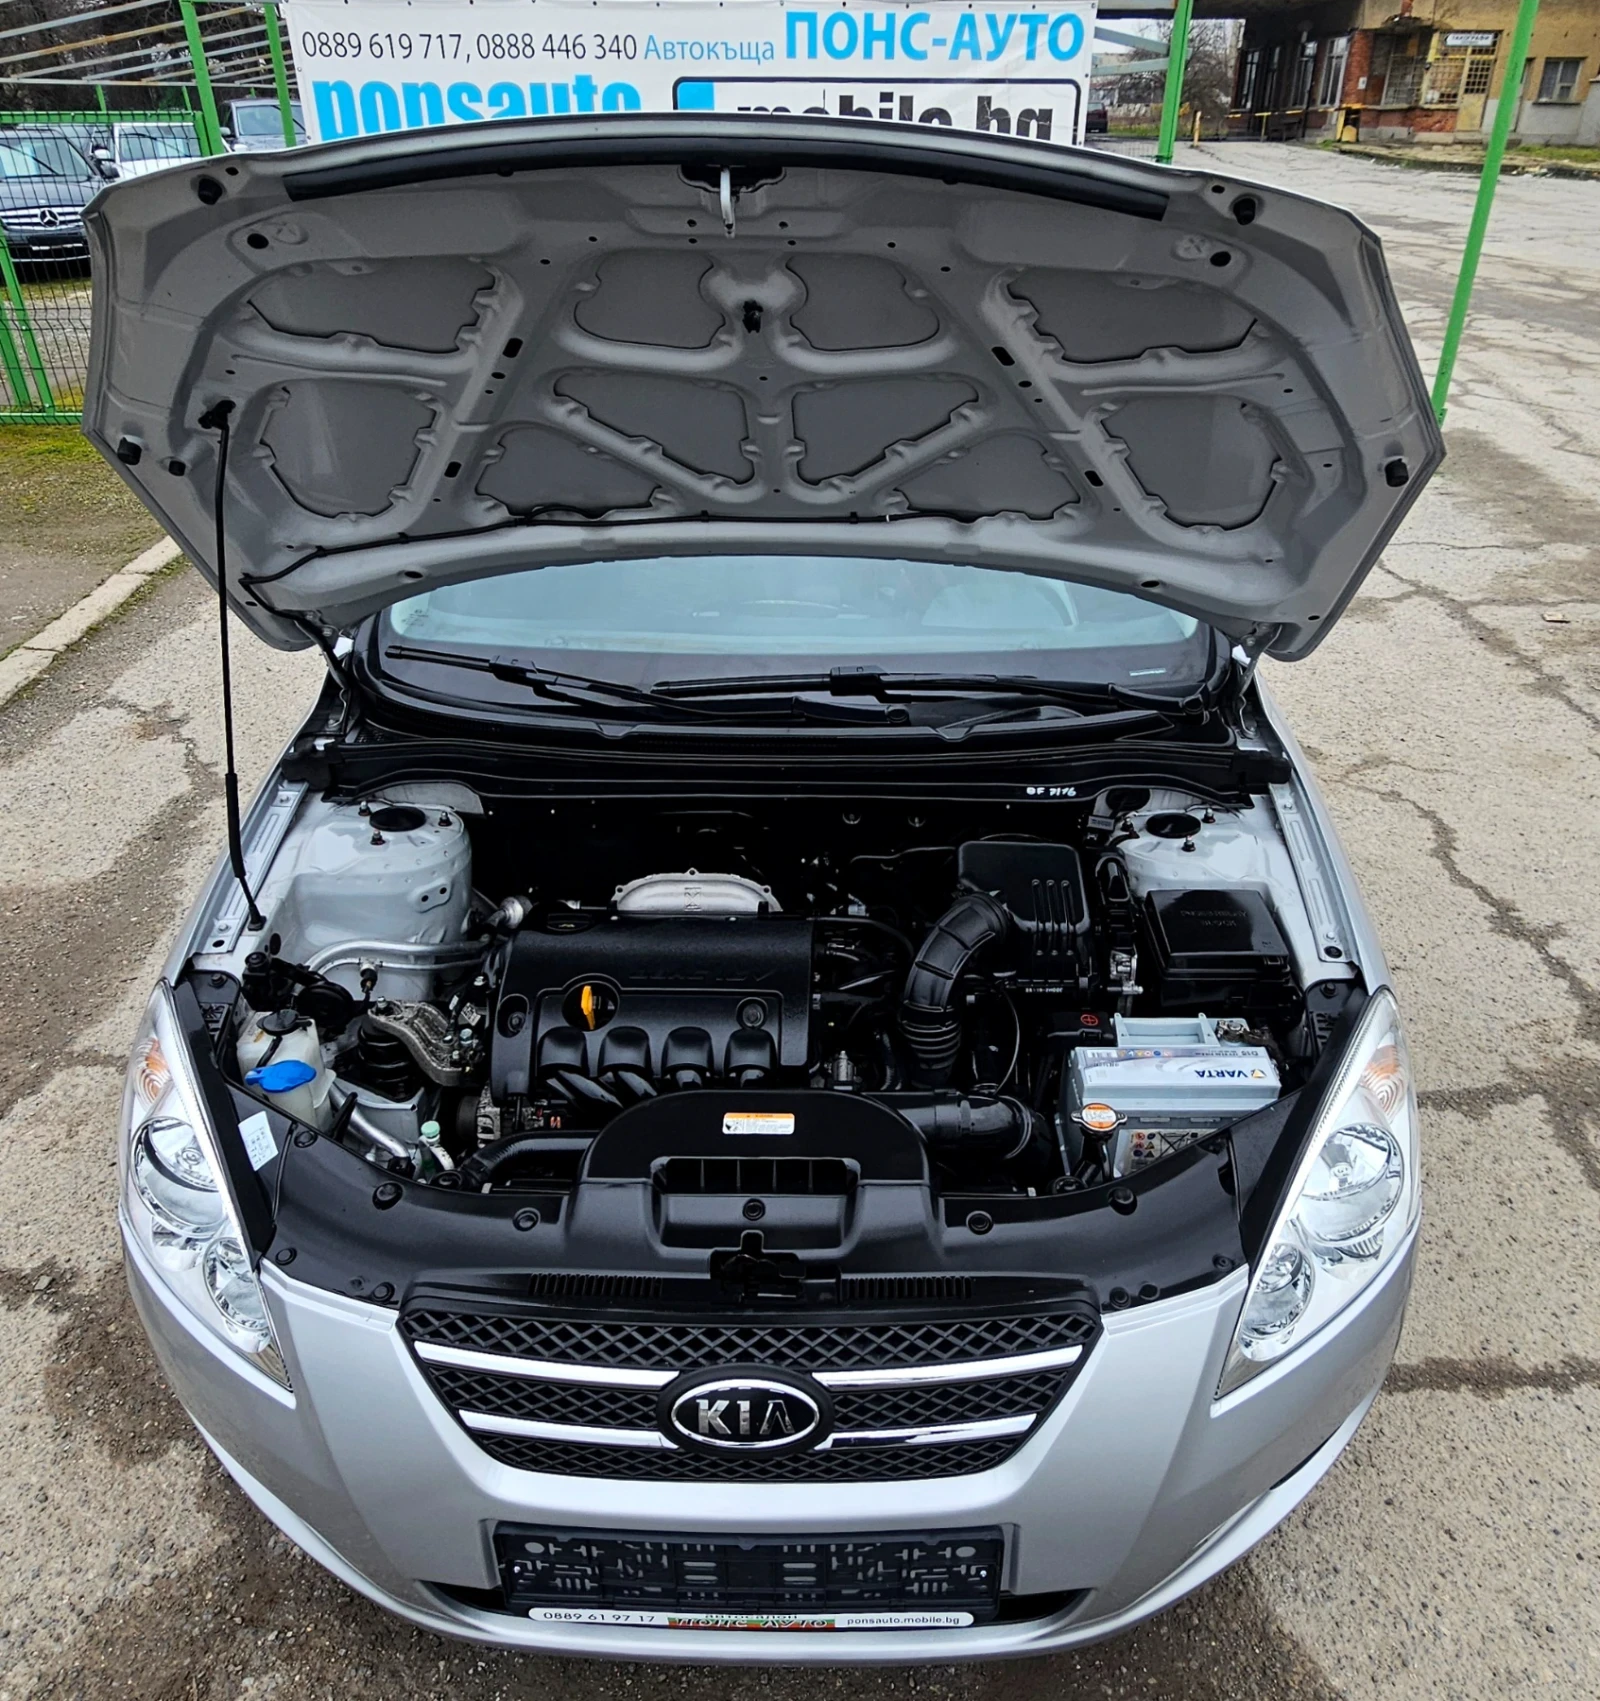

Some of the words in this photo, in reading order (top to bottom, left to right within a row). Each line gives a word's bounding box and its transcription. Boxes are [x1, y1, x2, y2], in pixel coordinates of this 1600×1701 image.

[302, 31, 362, 59] 0889
[369, 32, 413, 60] 619
[419, 33, 471, 64] 717,
[476, 33, 536, 60] 0888
[542, 34, 586, 60] 446
[593, 34, 637, 60] 340
[644, 34, 775, 65] Автокъща
[786, 11, 1085, 62] ПОНС-АУТО
[1194, 1069, 1249, 1079] VARTA
[696, 1399, 796, 1435] KIA
[543, 1611, 583, 1621] 0889
[587, 1612, 606, 1621] 61
[611, 1614, 631, 1622] 97
[639, 1615, 655, 1623] 17
[846, 1616, 961, 1627] ponsauto.mobile.bg
